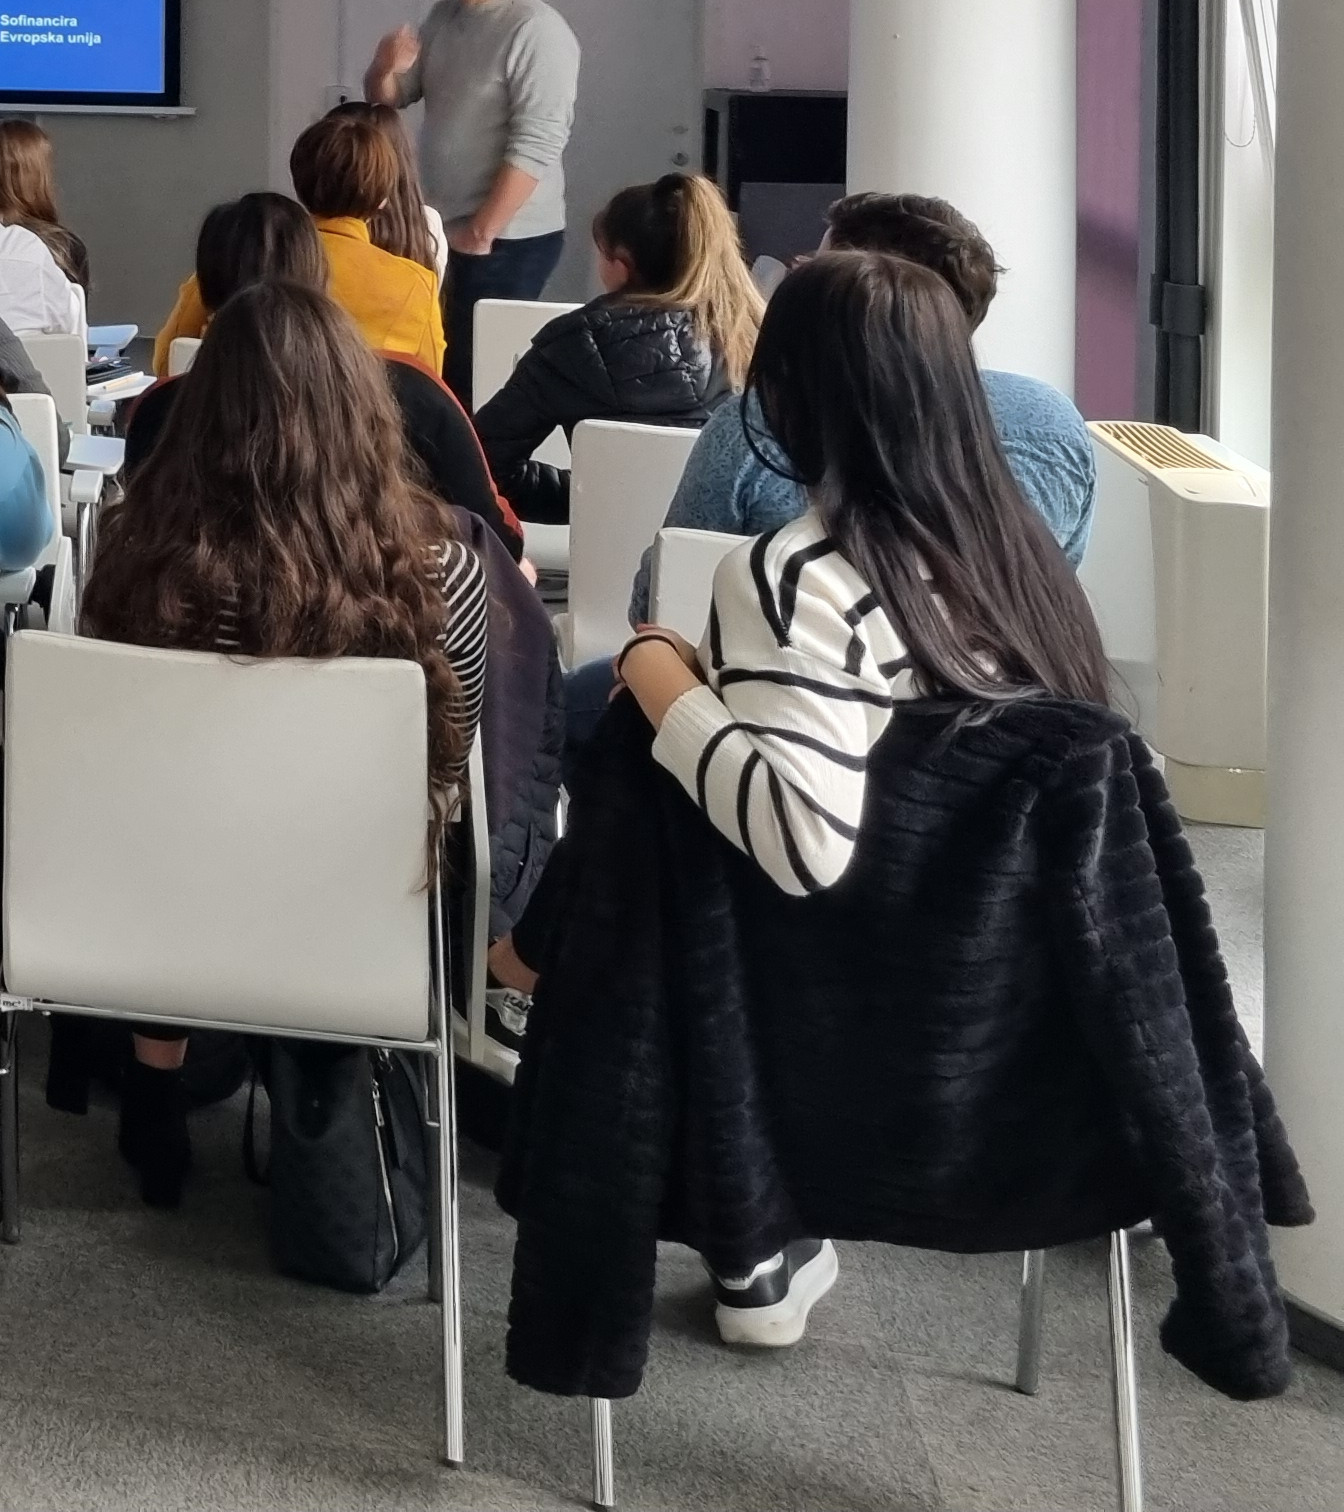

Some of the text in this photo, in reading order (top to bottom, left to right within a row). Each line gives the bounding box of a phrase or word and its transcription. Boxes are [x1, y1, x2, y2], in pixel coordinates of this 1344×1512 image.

[0, 14, 78, 27] Sofinancira
[0, 30, 102, 47] Evropska unija
